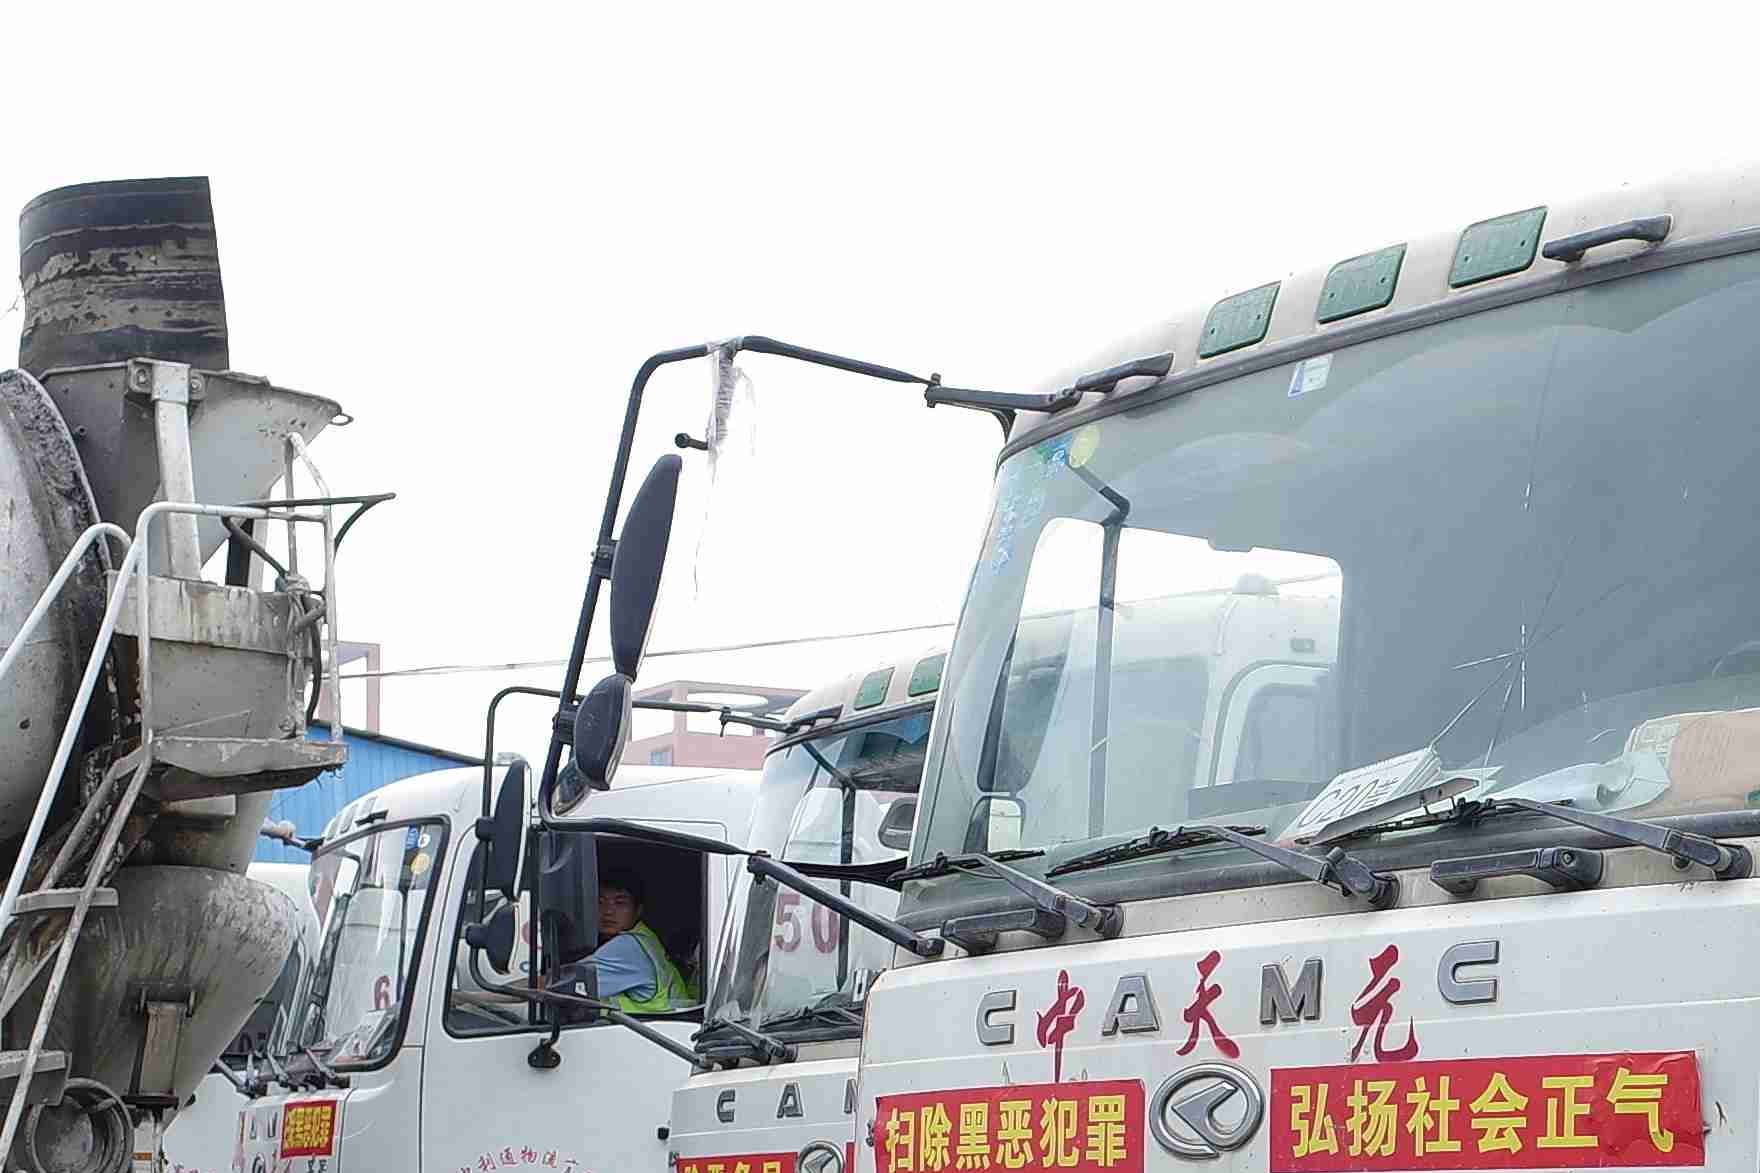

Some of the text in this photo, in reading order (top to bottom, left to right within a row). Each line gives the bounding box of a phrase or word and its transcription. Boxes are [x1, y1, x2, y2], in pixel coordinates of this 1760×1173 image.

[976, 939, 1501, 1047] CAMC
[1035, 944, 1419, 1082] 中天元
[884, 1094, 1128, 1173] 扫除黑恶犯罪
[1289, 1066, 1674, 1158] 弘扬社会正气
